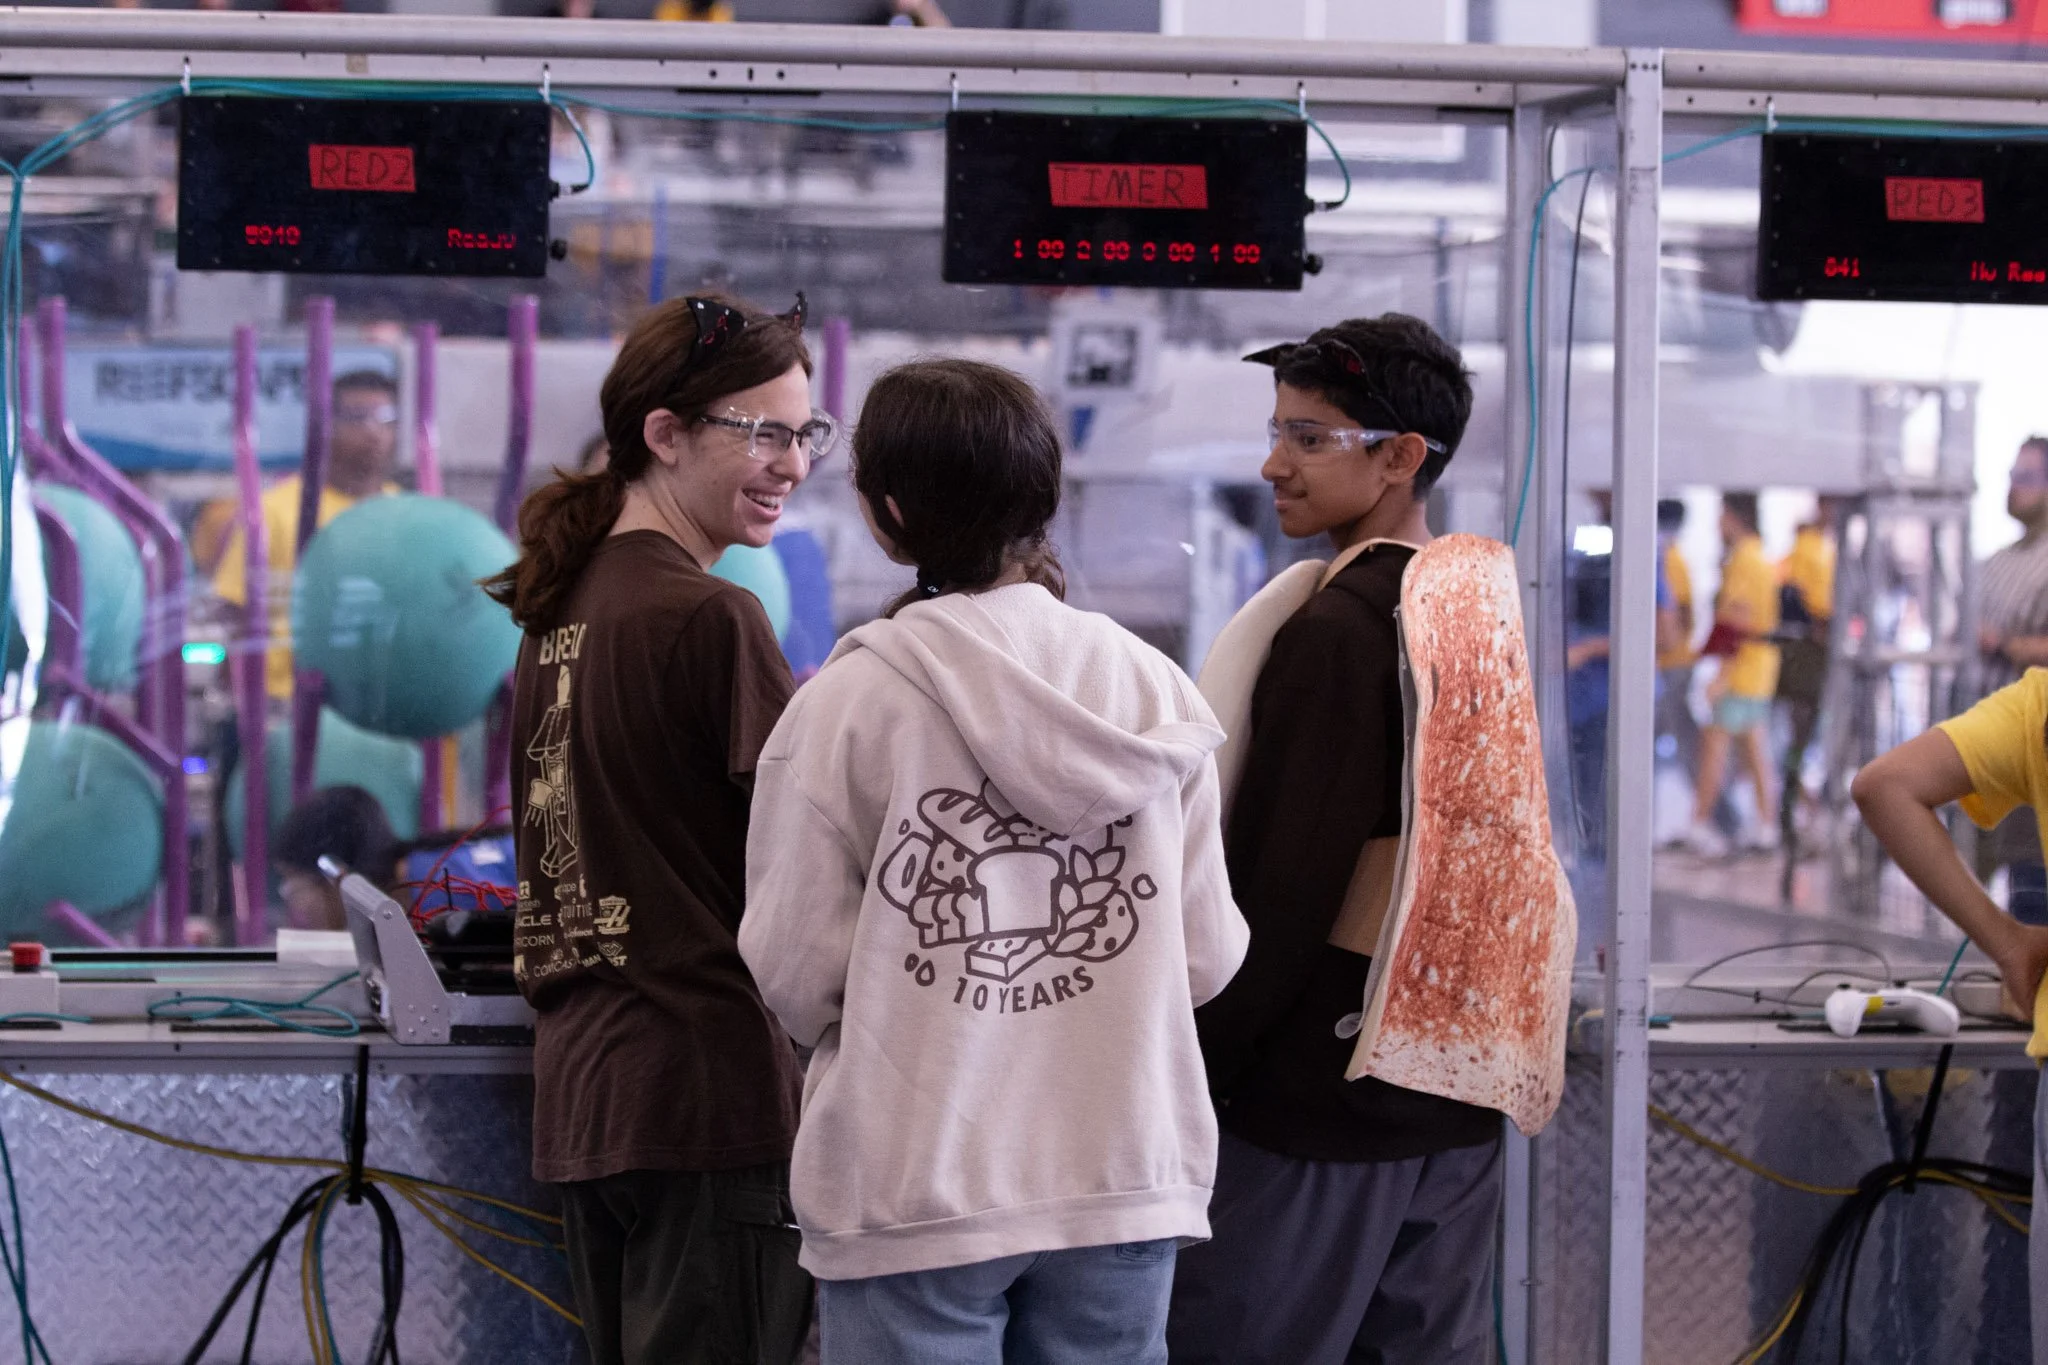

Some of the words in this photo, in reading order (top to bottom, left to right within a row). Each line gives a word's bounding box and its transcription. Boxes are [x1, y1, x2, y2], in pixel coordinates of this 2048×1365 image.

[1053, 165, 1185, 206] TIMER
[1038, 240, 1064, 259] 00
[1102, 241, 1129, 260] 00
[1168, 243, 1195, 262] 00
[1234, 244, 1260, 263] 00
[953, 977, 989, 1012] 10
[999, 965, 1095, 1014] YEARS
